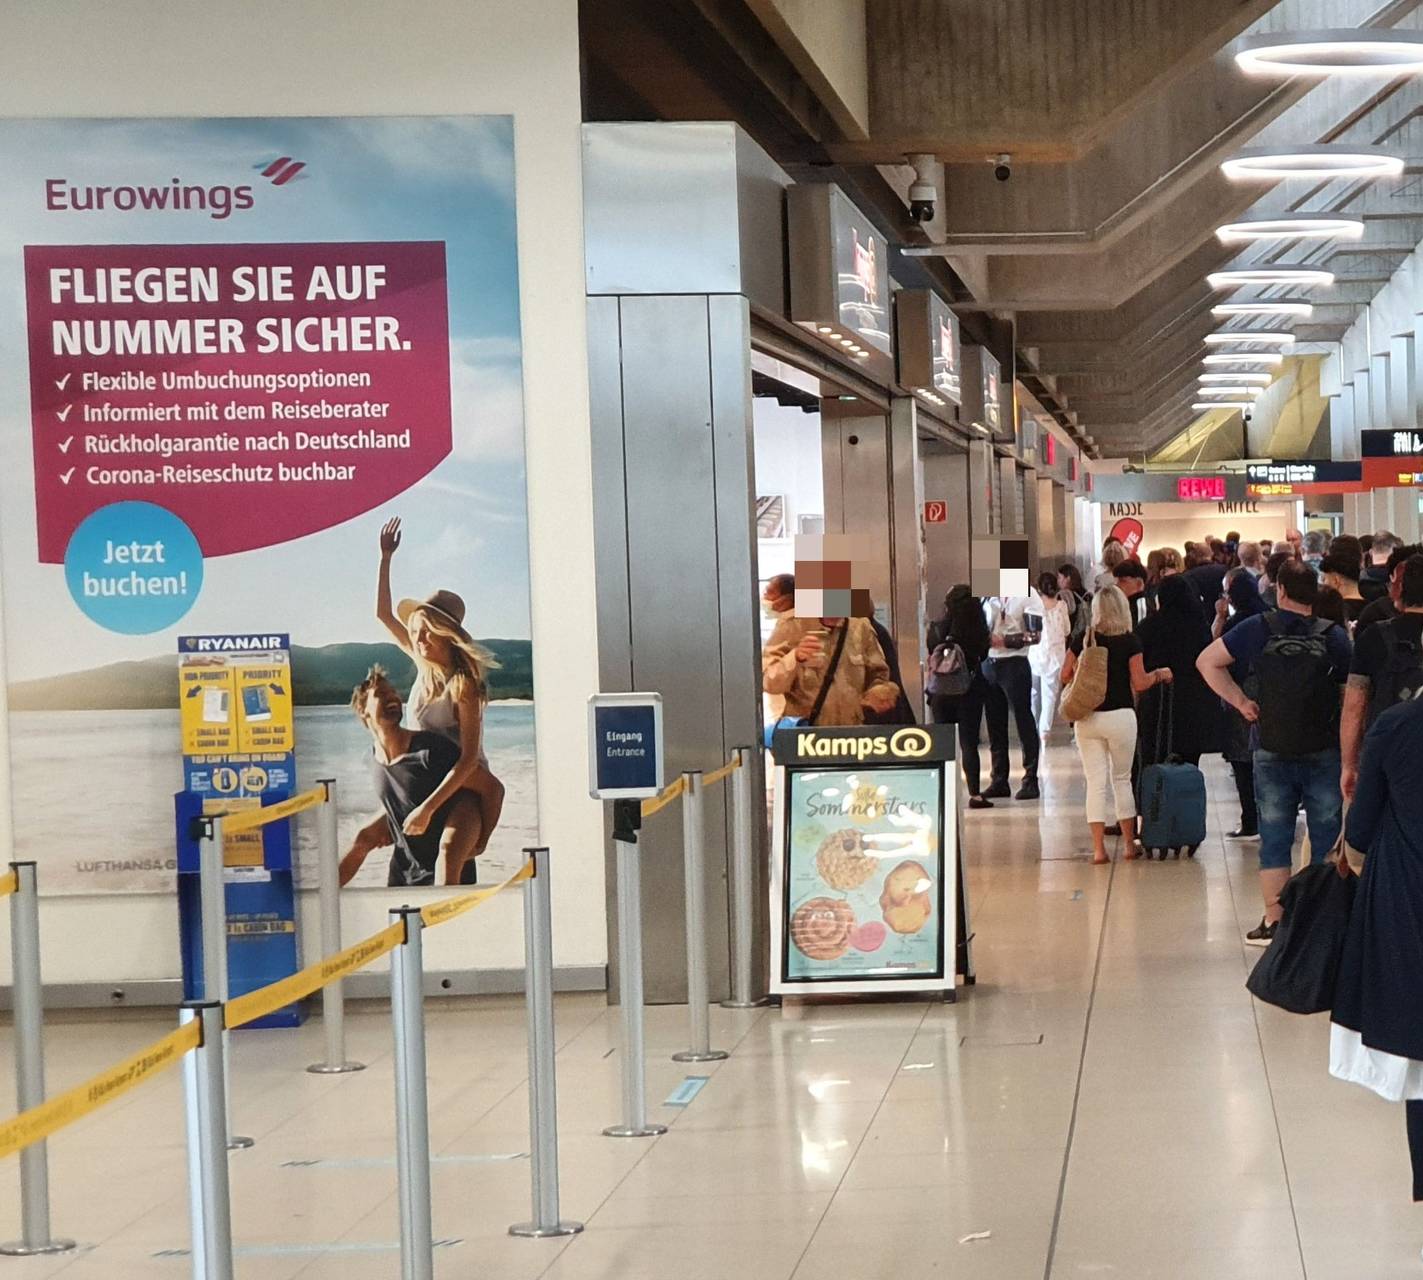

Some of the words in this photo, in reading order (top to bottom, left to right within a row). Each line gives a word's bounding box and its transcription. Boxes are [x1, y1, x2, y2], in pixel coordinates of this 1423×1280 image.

[45, 178, 254, 219] Eurowings
[49, 267, 219, 303] FLIEGEN
[232, 266, 294, 302] SIE
[306, 265, 386, 301] AUF
[52, 318, 246, 356] NUMMER
[257, 316, 412, 354] SICHER.
[82, 371, 156, 391] Flexible
[162, 369, 371, 394] Umbuchungsoptionen
[84, 401, 182, 422] Informiert
[187, 402, 219, 420] mit
[224, 401, 266, 420] dem
[272, 399, 390, 420] Reiseberater
[85, 432, 240, 457] Rückholgarantie
[245, 431, 289, 451] nach
[295, 429, 411, 450] Deutschland
[87, 464, 272, 486] Corona-Reiseschutz
[279, 462, 356, 483] buchbar
[1178, 477, 1226, 498] REWE
[103, 540, 165, 566] Jetzt
[83, 571, 187, 597] buchen!
[198, 636, 282, 651] RYANAIR
[606, 730, 642, 743] Eingang
[797, 733, 887, 760] Kamps
[607, 746, 646, 757] Entrance
[77, 858, 163, 873] LUFTHANSA
